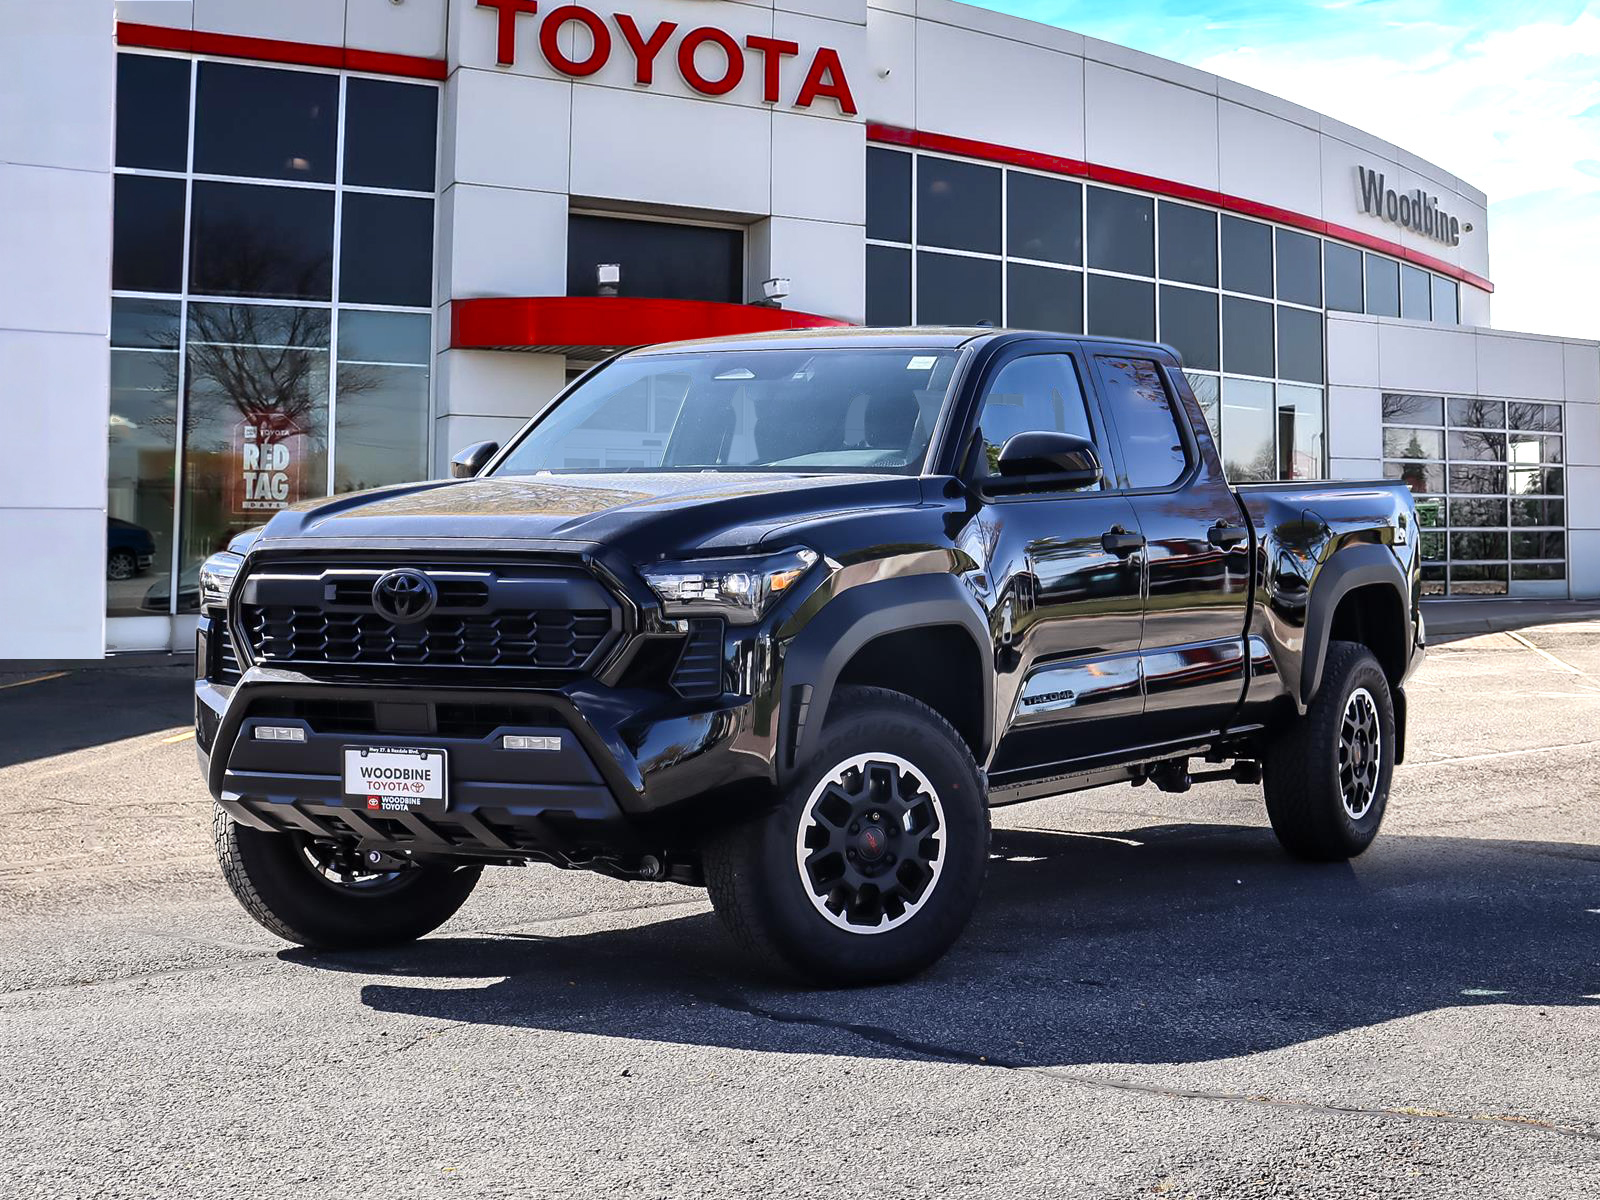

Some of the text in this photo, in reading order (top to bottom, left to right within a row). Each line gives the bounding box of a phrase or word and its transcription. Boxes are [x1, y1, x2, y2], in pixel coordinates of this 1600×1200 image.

[475, 0, 858, 116] TOYOTA
[1356, 165, 1460, 247] Woodbine
[260, 429, 290, 437] TOYOTA
[243, 443, 290, 471] RED
[243, 472, 289, 500] TAG
[360, 767, 431, 780] WOODBINE
[367, 781, 410, 792] TOYOTA
[381, 796, 421, 805] WOODBINE
[381, 803, 409, 812] TOYOTA
